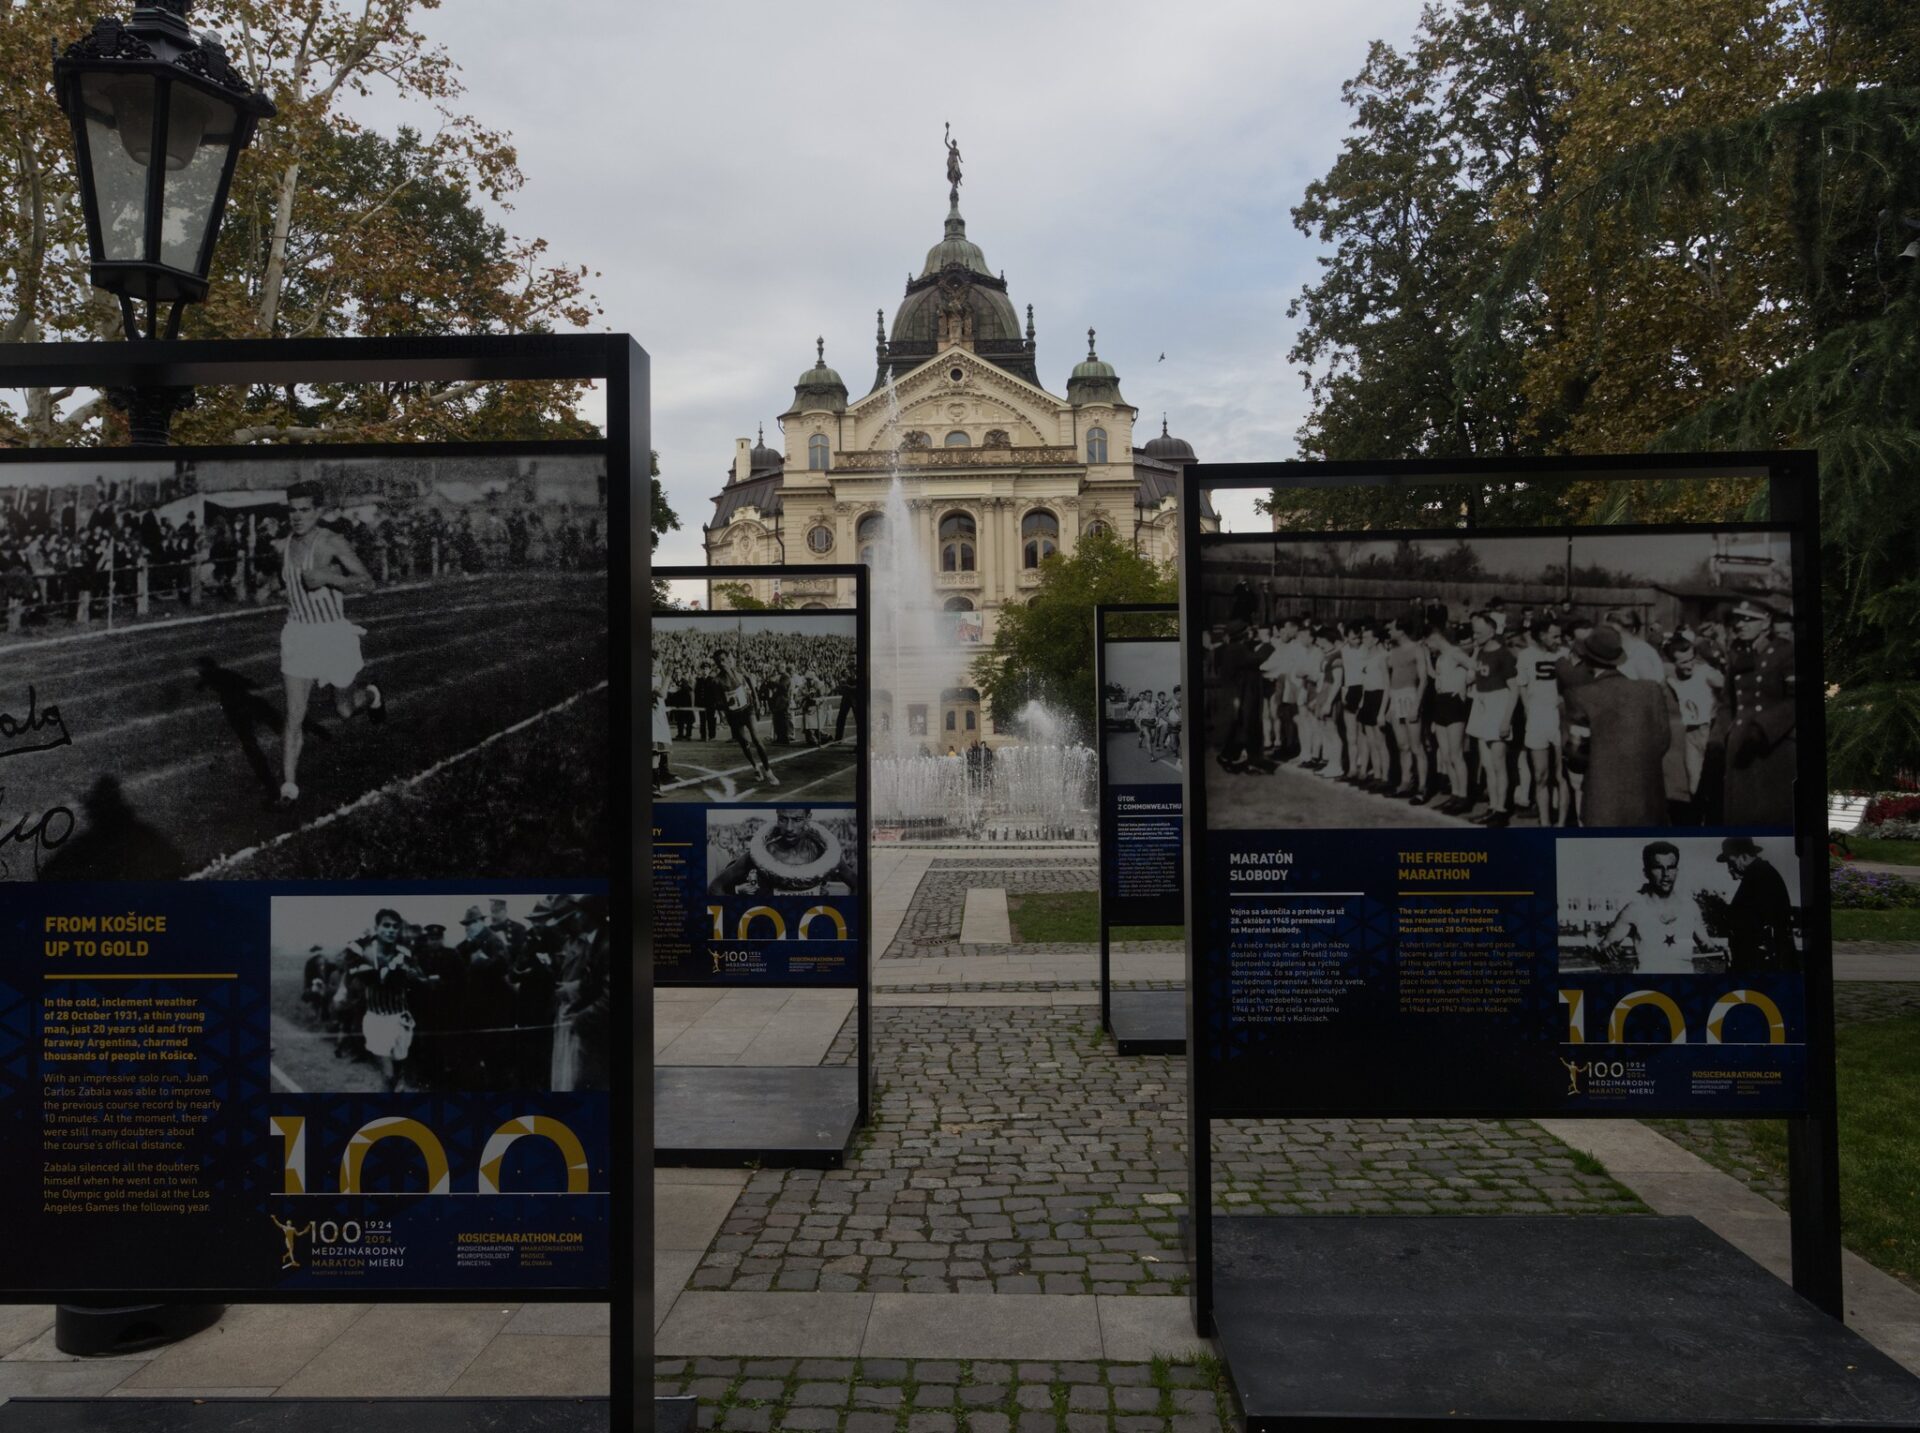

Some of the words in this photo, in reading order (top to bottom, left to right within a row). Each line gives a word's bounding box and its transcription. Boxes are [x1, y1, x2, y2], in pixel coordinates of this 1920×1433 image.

[1536, 662, 1555, 680] S
[1230, 850, 1293, 864] MARATÓN
[1398, 852, 1423, 863] THE
[1426, 851, 1488, 863] FREEDOM
[1230, 869, 1289, 881] SLOBODY
[1398, 868, 1470, 881] MARATHON
[1230, 908, 1250, 916] Vojna
[1261, 907, 1290, 915] skončila
[1297, 908, 1325, 916] preteky
[1336, 907, 1345, 915] už
[45, 916, 97, 933] FROM
[101, 911, 166, 933] KOŠICE
[1290, 917, 1335, 925] premenovali
[1241, 926, 1270, 934] Maratón
[1271, 926, 1301, 935] slobody.
[44, 941, 70, 957] UP
[73, 941, 96, 957] TO
[100, 941, 149, 957] GOLD
[44, 999, 55, 1007] In
[56, 998, 73, 1007] the
[75, 998, 100, 1009] cold,
[102, 998, 153, 1007] inclement
[155, 998, 198, 1007] weather
[44, 1011, 55, 1021] of
[56, 1012, 69, 1021] 28
[71, 1012, 112, 1021] October
[114, 1012, 141, 1022] 1931,
[152, 1011, 172, 1020] thin
[174, 1013, 205, 1022] young
[44, 1027, 69, 1035] man,
[71, 1025, 91, 1035] just
[93, 1025, 105, 1034] 20
[107, 1027, 136, 1035] years
[138, 1025, 154, 1034] old
[157, 1025, 176, 1034] and
[178, 1025, 203, 1033] from
[44, 1038, 85, 1048] faraway
[87, 1038, 141, 1049] Argentina,
[143, 1038, 188, 1047] charmed
[44, 1052, 97, 1061] thousands
[99, 1051, 109, 1061] of
[111, 1052, 146, 1062] people
[148, 1051, 158, 1060] in
[160, 1051, 197, 1060] Košice.
[1587, 1062, 1624, 1078] 100
[43, 1074, 66, 1083] With
[84, 1074, 135, 1084] impressive
[139, 1074, 159, 1082] solo
[162, 1075, 181, 1084] run,
[185, 1074, 208, 1082] Juan
[44, 1087, 76, 1096] Carlos
[78, 1087, 111, 1096] Zabala
[135, 1087, 156, 1096] able
[159, 1088, 170, 1096] to
[172, 1088, 211, 1097] improve
[44, 1102, 59, 1110] the
[62, 1101, 103, 1111] previous
[142, 1101, 173, 1110] record
[176, 1101, 187, 1111] by
[190, 1101, 221, 1111] nearly
[58, 1115, 98, 1123] minutes.
[103, 1115, 114, 1123] At
[116, 1114, 133, 1123] the
[135, 1115, 179, 1124] moment,
[182, 1114, 208, 1122] there
[70, 1128, 89, 1136] still
[92, 1129, 118, 1138] many
[121, 1128, 164, 1136] doubters
[167, 1128, 195, 1136] about
[44, 1141, 59, 1150] the
[62, 1141, 103, 1150] course's
[106, 1141, 138, 1150] official
[141, 1140, 185, 1150] distance.
[43, 1163, 76, 1172] Zabala
[79, 1162, 119, 1172] silenced
[123, 1162, 135, 1172] all
[137, 1162, 153, 1172] the
[155, 1162, 199, 1172] doubters
[44, 1176, 80, 1185] himself
[83, 1176, 110, 1185] when
[112, 1176, 124, 1185] he
[127, 1177, 150, 1185] went
[168, 1176, 177, 1185] to
[180, 1176, 197, 1184] win
[44, 1190, 59, 1199] the
[62, 1189, 101, 1200] Olympic
[103, 1189, 125, 1200] gold
[128, 1189, 158, 1198] medal
[161, 1190, 171, 1198] at
[173, 1189, 190, 1198] the
[193, 1189, 210, 1198] Los
[44, 1203, 83, 1214] Angeles
[86, 1203, 119, 1212] Games
[123, 1203, 138, 1212] the
[140, 1203, 185, 1213] following
[187, 1204, 210, 1214] year.
[365, 1221, 392, 1229] 1924
[310, 1220, 362, 1244] 100
[365, 1235, 392, 1244] 2024
[458, 1233, 582, 1243] KOSICEMARATHON.COM
[369, 1258, 404, 1267] MIERU
